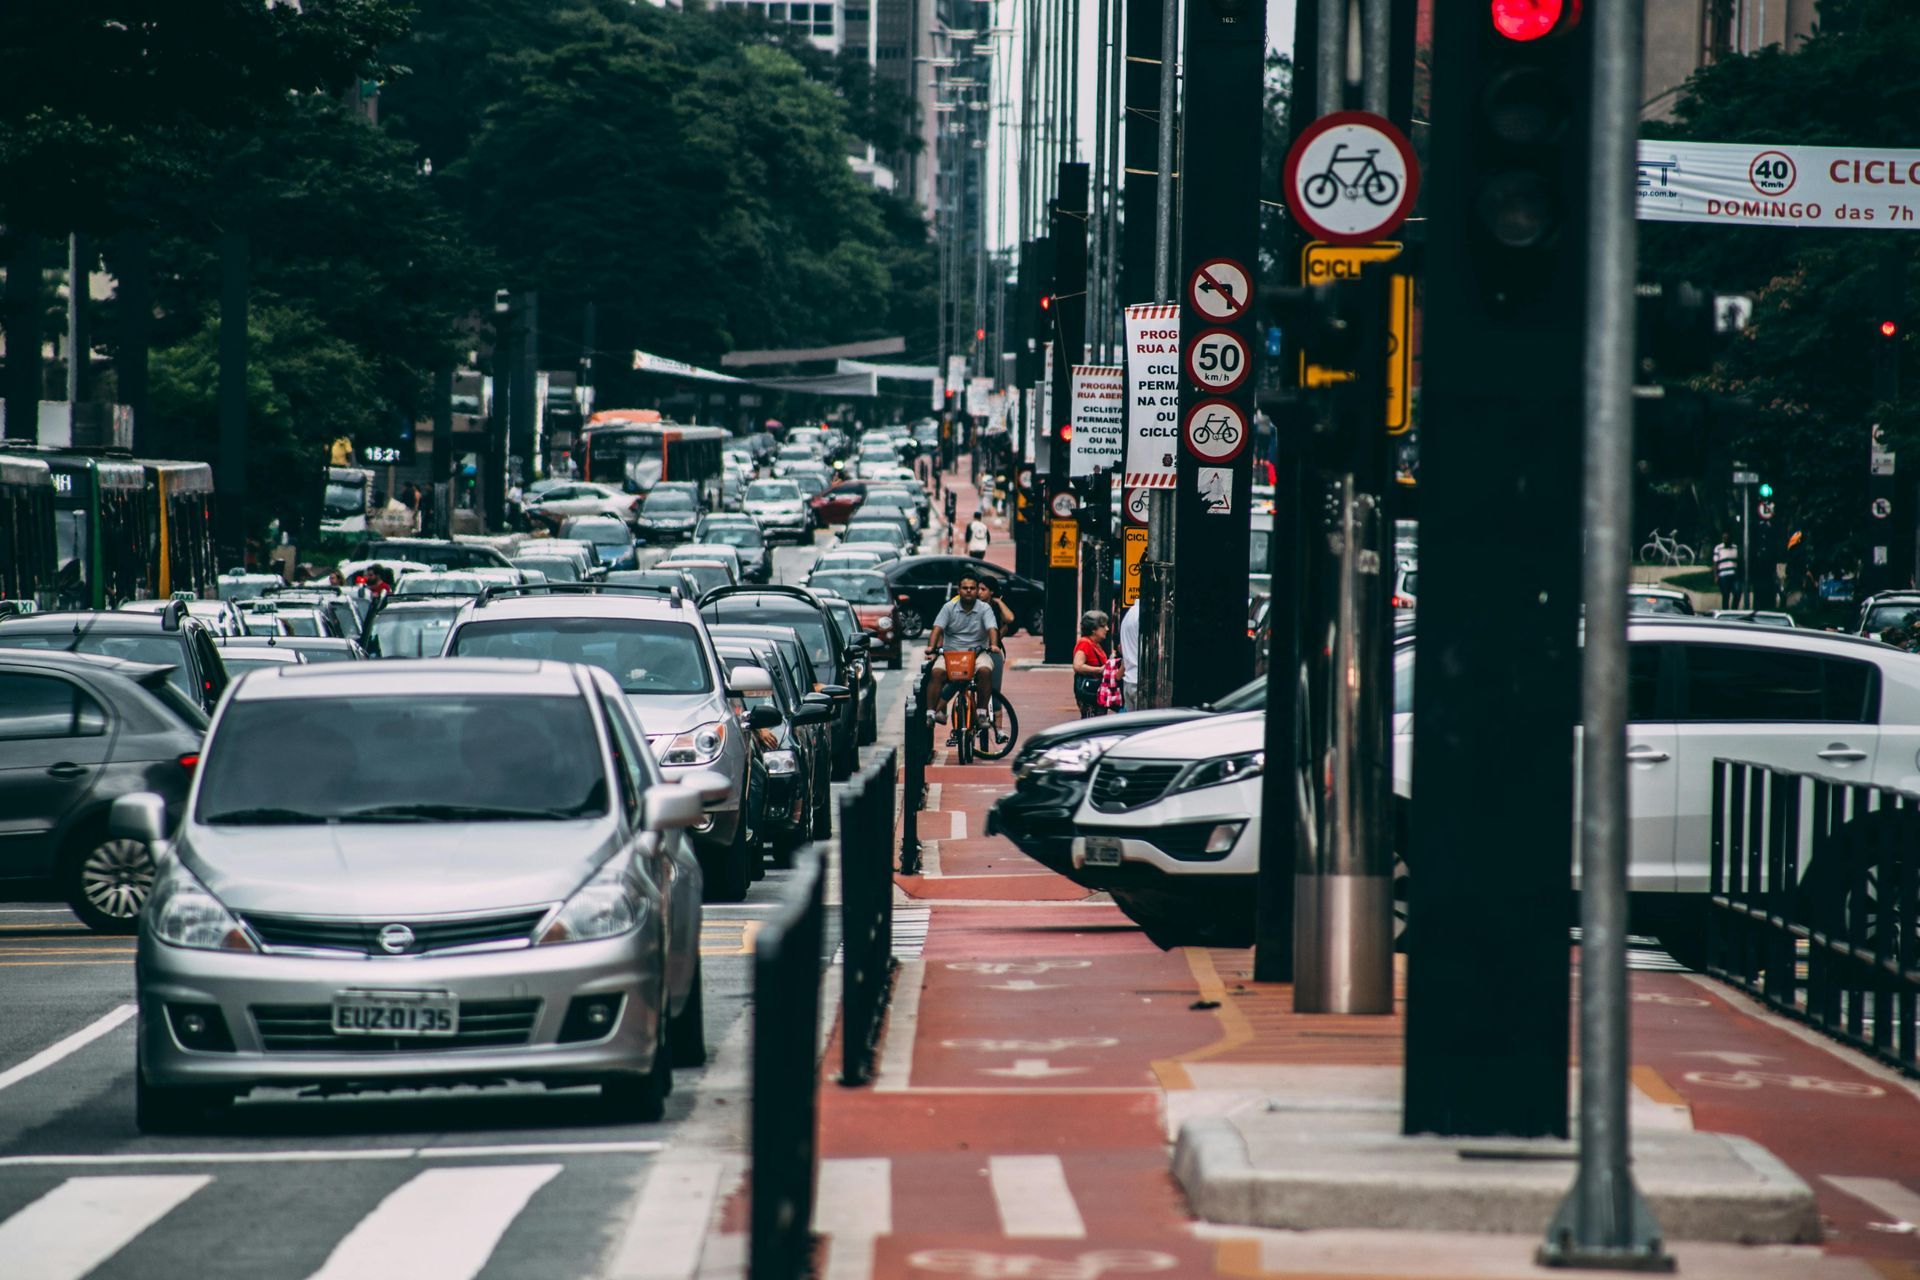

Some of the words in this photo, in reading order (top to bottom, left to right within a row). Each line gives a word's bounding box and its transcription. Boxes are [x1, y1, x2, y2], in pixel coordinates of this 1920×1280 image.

[1755, 160, 1788, 179] 40
[1760, 181, 1784, 189] Km/h
[1637, 190, 1677, 198] sp.com.br
[1707, 199, 1822, 219] DOMINGO
[1835, 203, 1874, 220] das
[1888, 205, 1914, 221] 7h
[1140, 330, 1178, 340] PROG
[1136, 344, 1165, 354] RUA
[1199, 343, 1240, 371] 50
[1147, 365, 1178, 375] CICL
[1204, 373, 1230, 382] km/h
[1077, 391, 1097, 399] RUA
[1137, 396, 1156, 406] NA
[1156, 412, 1176, 422] OU
